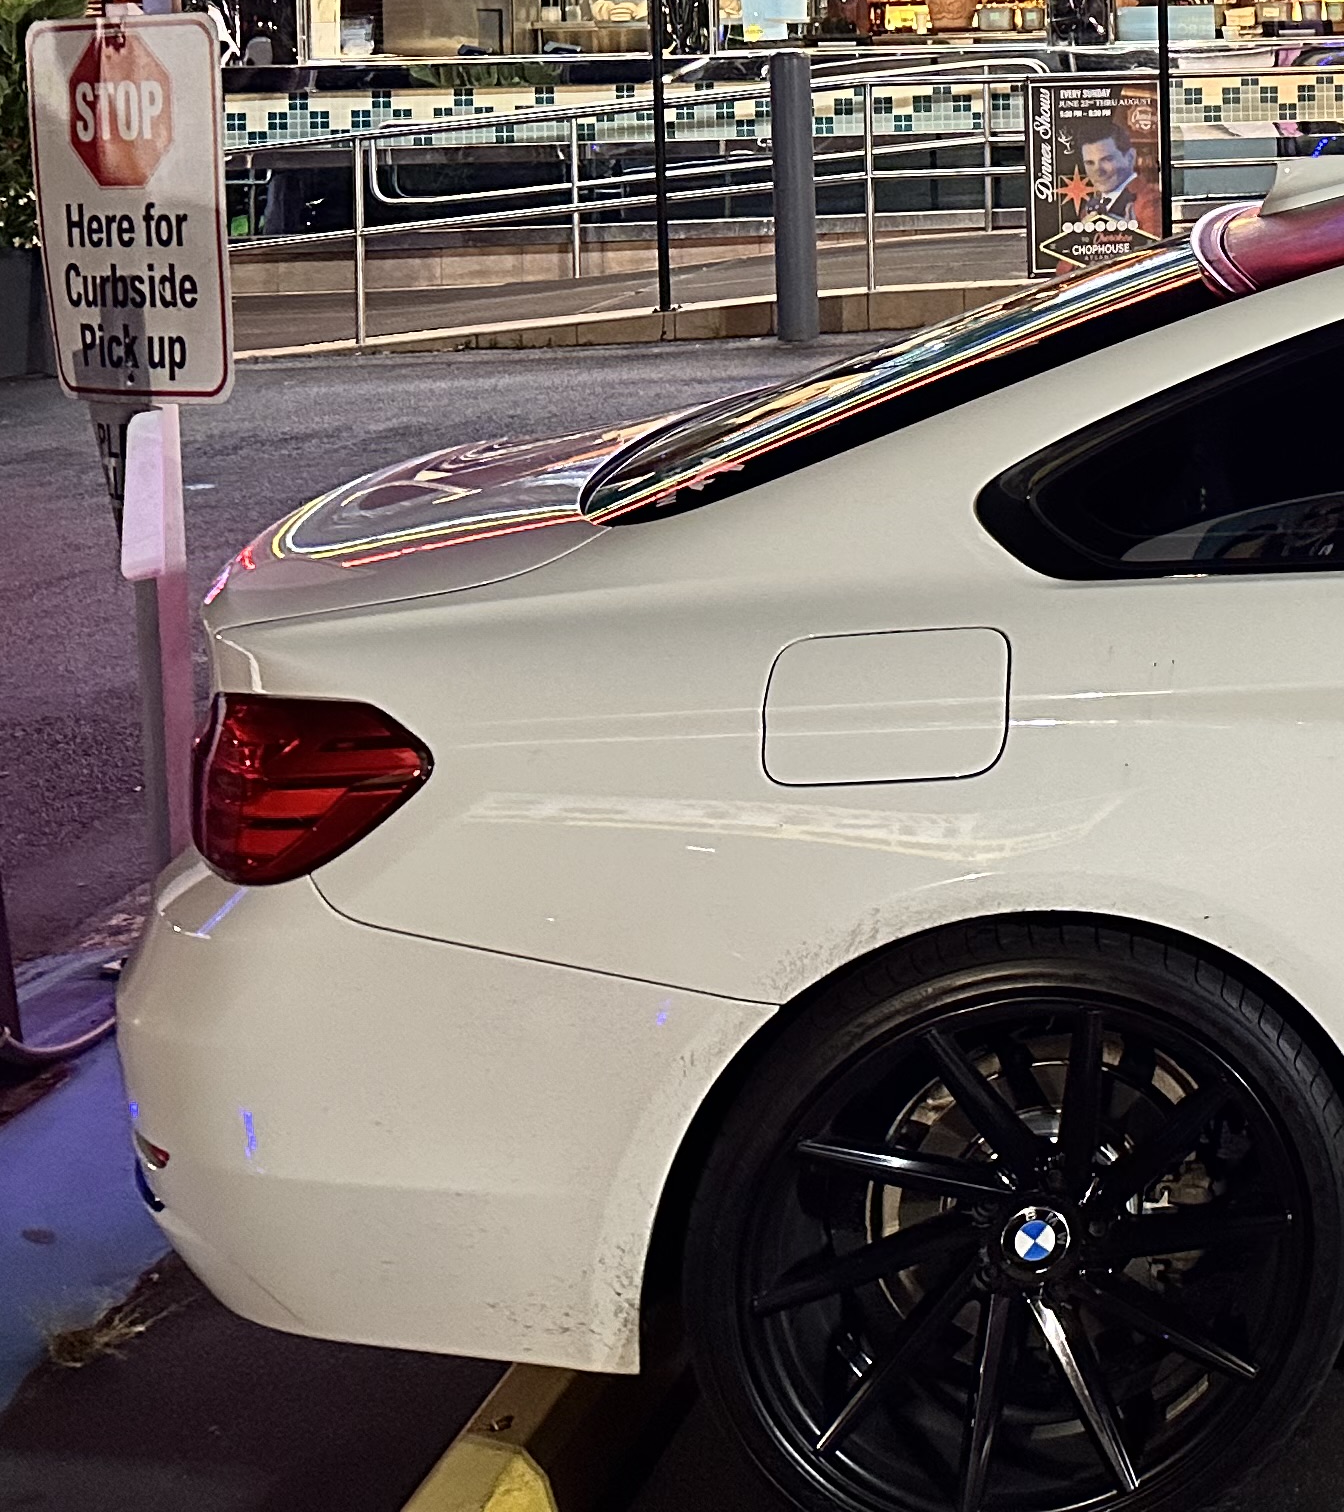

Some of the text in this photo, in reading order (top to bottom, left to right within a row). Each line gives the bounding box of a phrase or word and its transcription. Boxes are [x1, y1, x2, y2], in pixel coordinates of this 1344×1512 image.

[75, 80, 163, 142] STOP
[1059, 88, 1111, 99] EVERY SUNDAY
[1095, 98, 1117, 107] THRU
[1118, 98, 1151, 106] AUGUST
[1033, 87, 1053, 203] Dinner Shows
[64, 202, 188, 247] Here for
[1072, 243, 1130, 255] CHOPHOUSE
[64, 263, 198, 309] Curbside
[81, 323, 187, 380] Pick up
